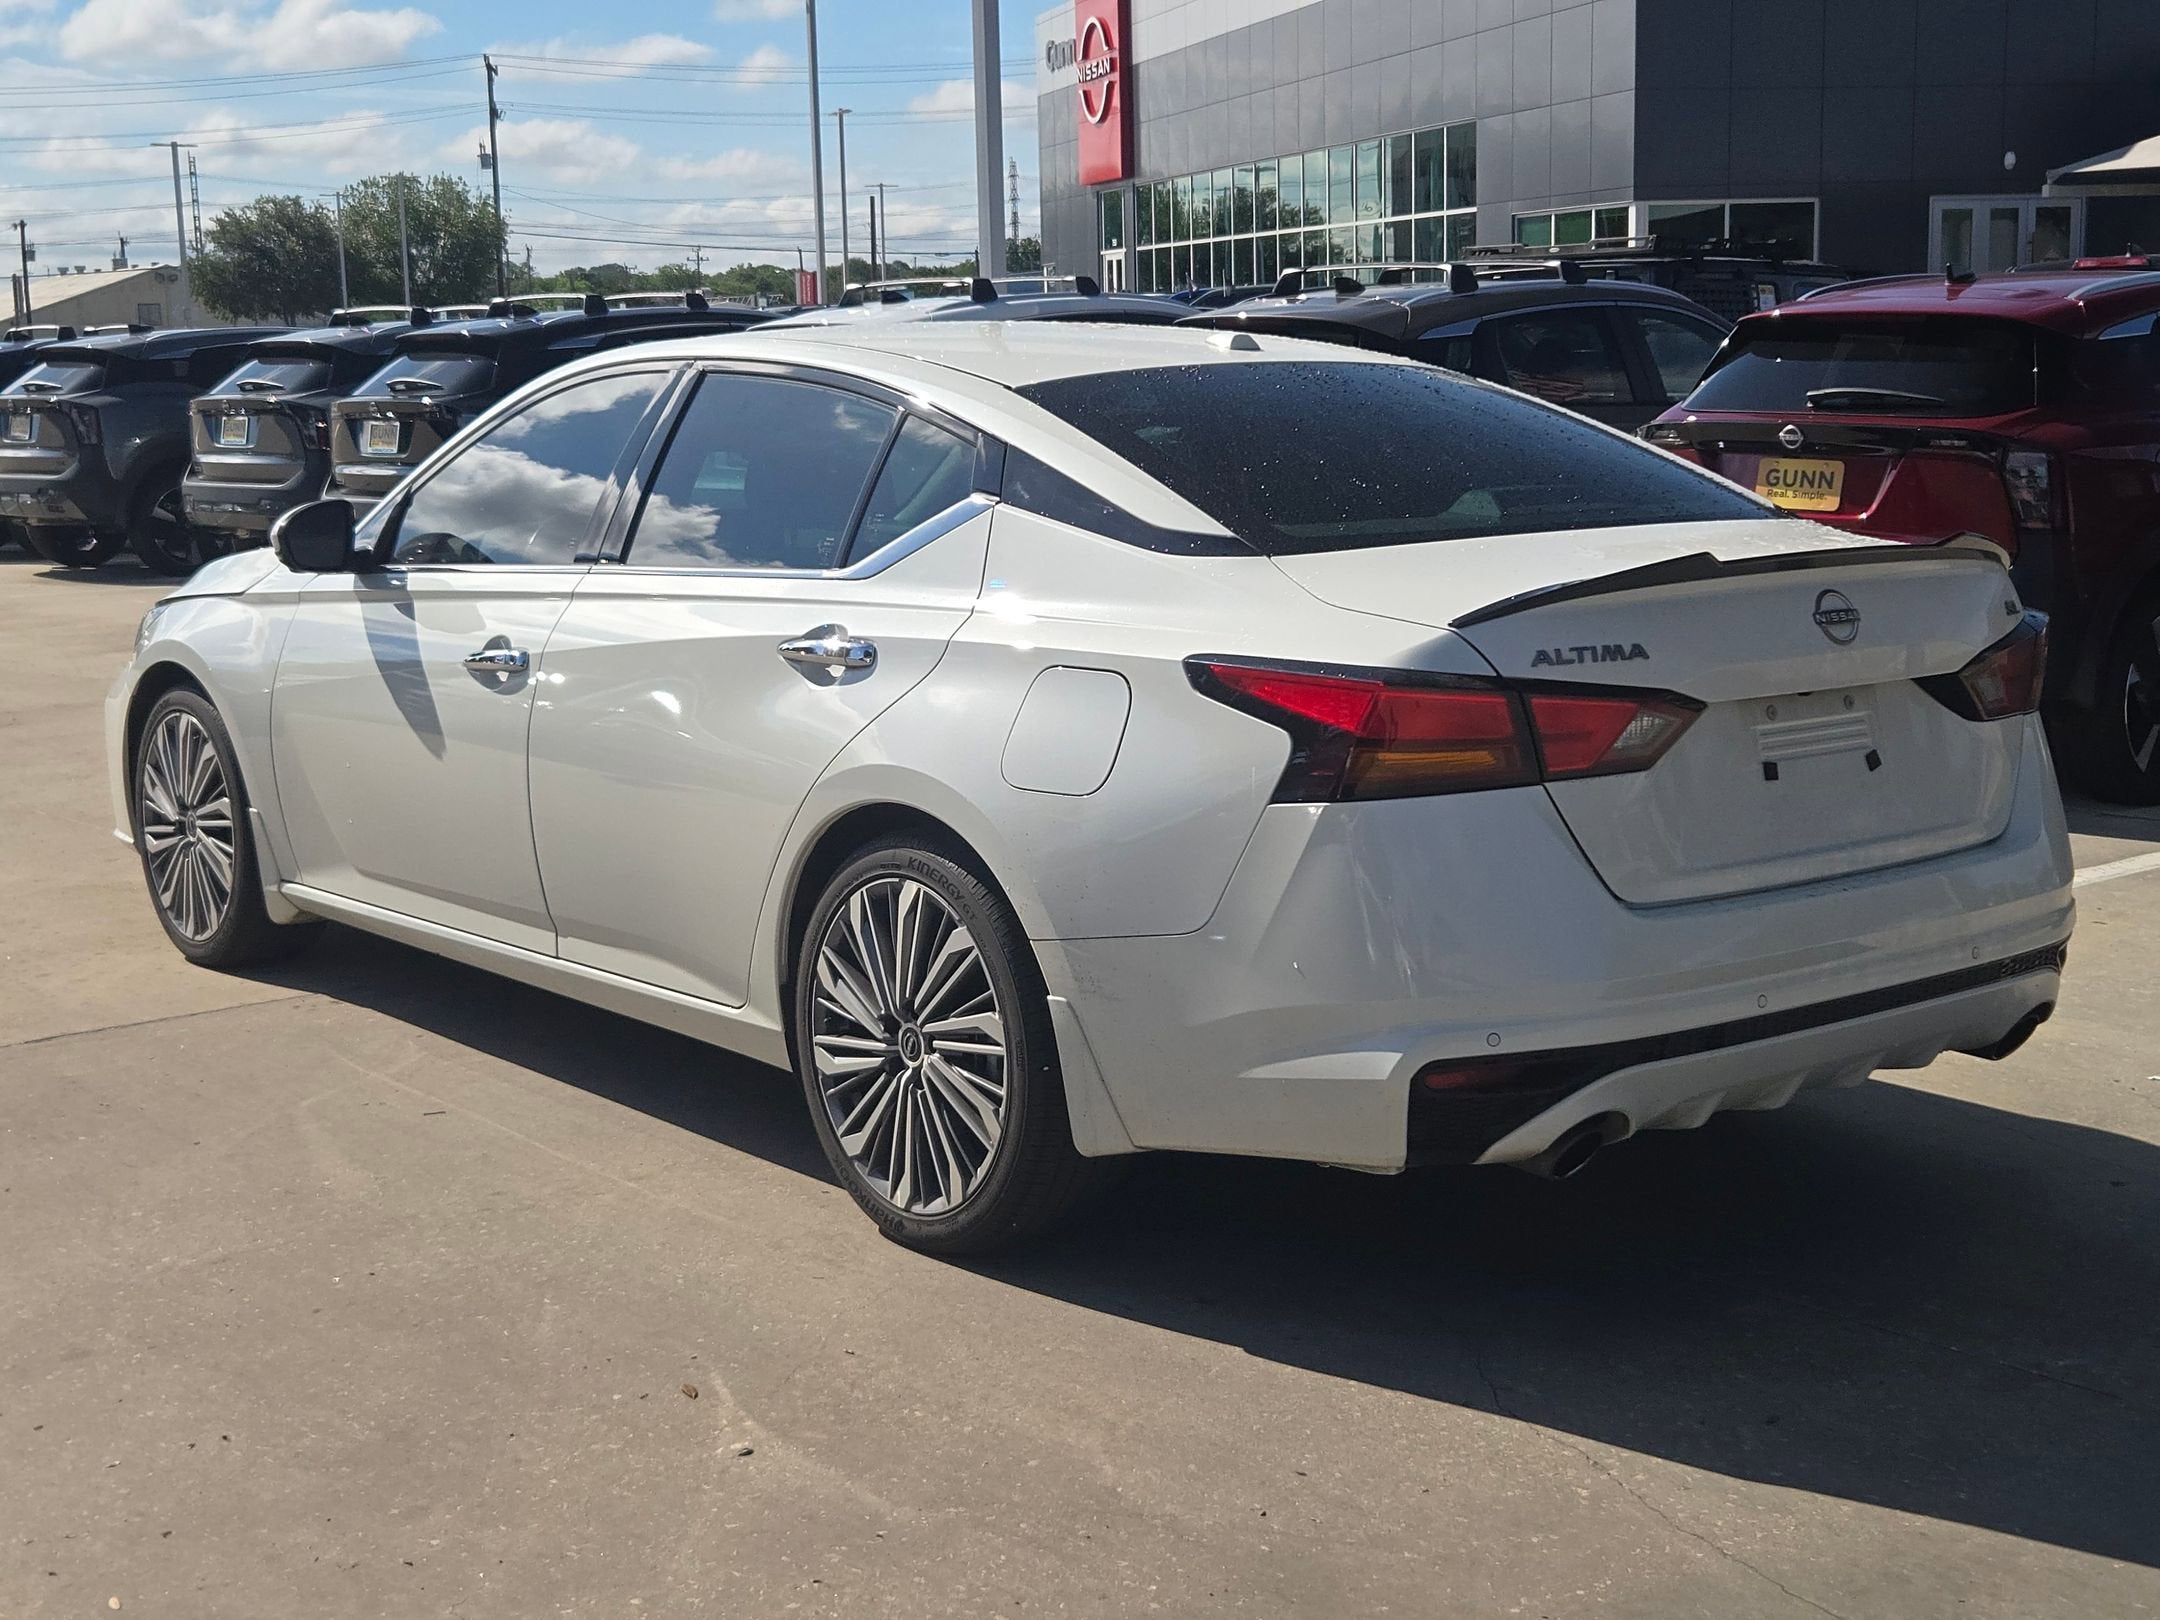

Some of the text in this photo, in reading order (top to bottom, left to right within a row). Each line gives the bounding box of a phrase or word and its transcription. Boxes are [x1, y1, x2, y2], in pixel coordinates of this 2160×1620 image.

[1077, 56, 1110, 84] NISSAN
[1765, 468, 1835, 490] GUNN
[1767, 488, 1790, 499] Real.
[1791, 489, 1828, 502] Simple.
[1531, 643, 1650, 668] ALTIMA
